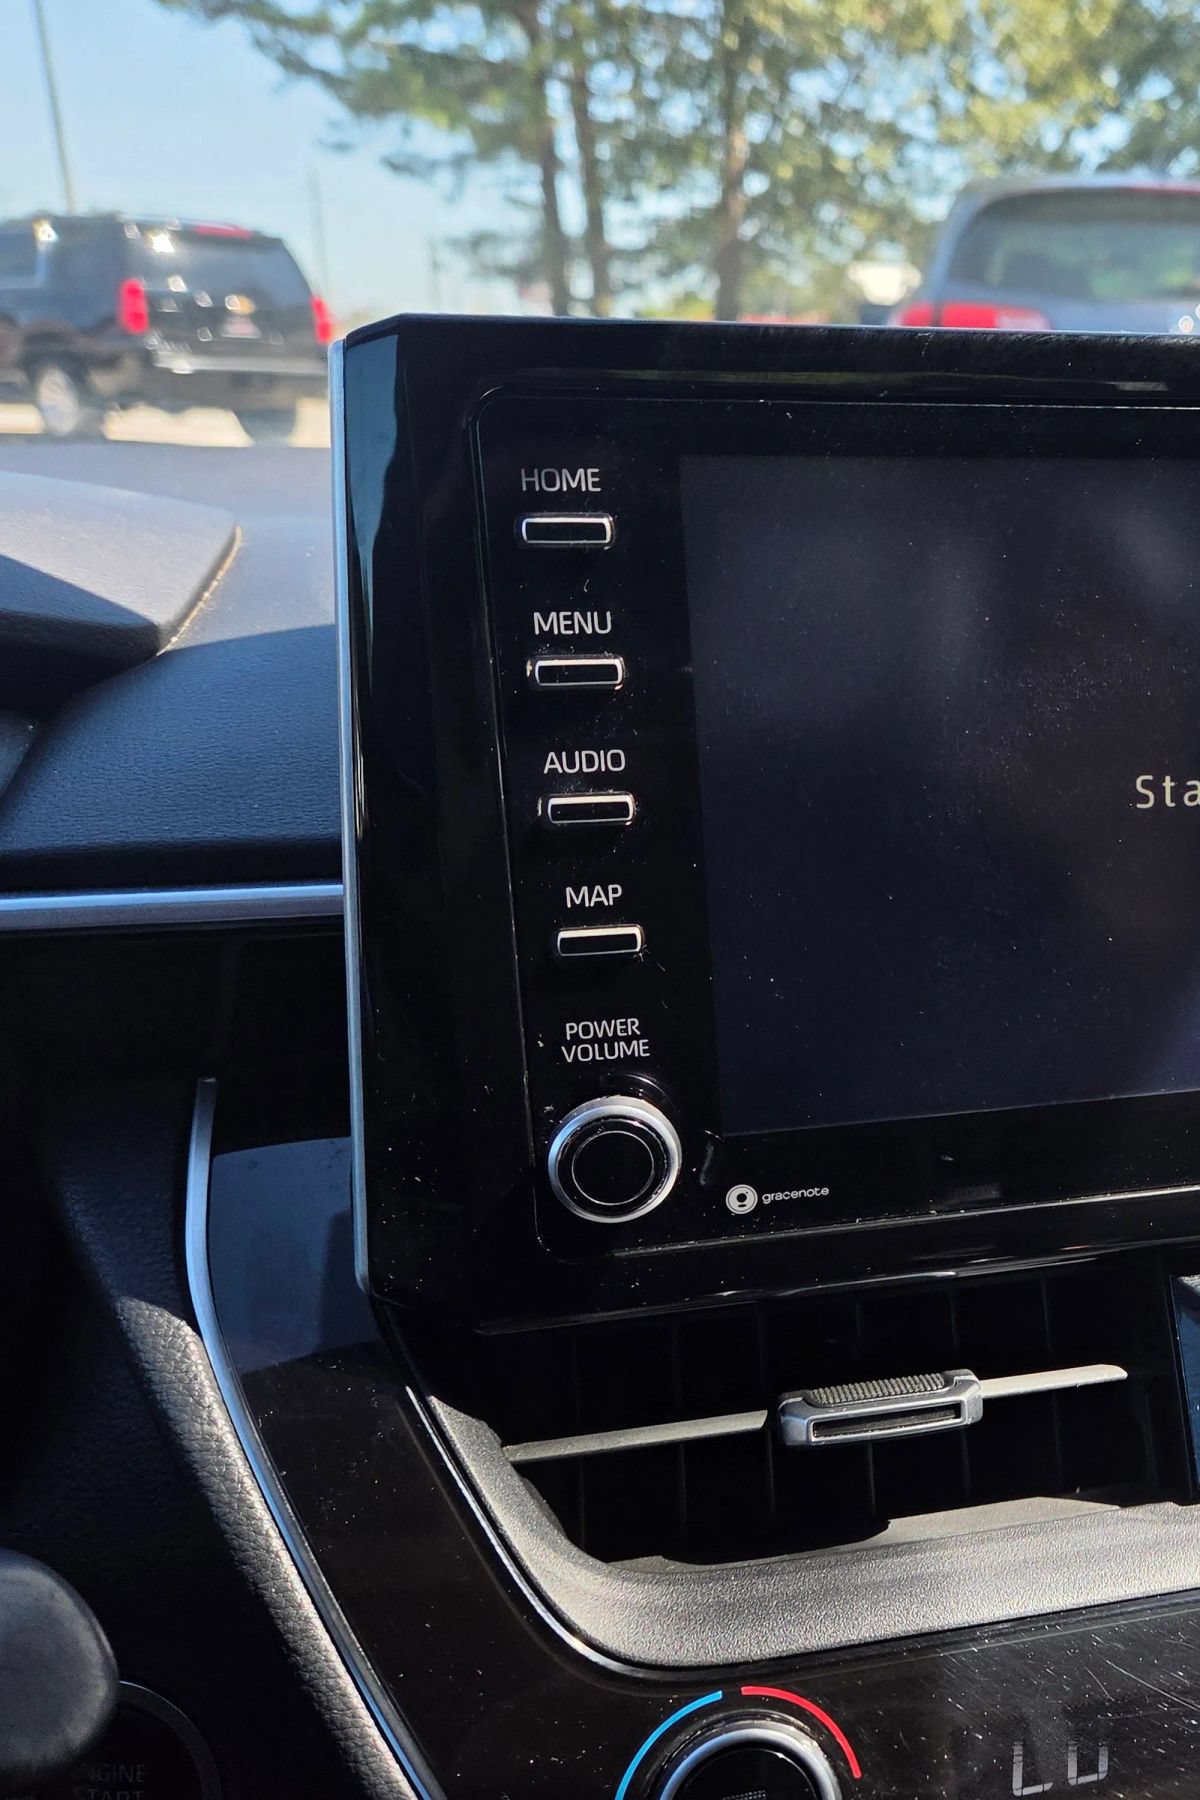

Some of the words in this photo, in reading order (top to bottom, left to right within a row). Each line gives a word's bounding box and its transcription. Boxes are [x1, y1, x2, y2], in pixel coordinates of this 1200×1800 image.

[521, 468, 601, 492] HOME
[533, 610, 612, 635] MENU
[543, 750, 626, 774] AUDIO
[565, 884, 623, 908] MAP
[565, 1018, 641, 1040] POWER
[561, 1039, 650, 1063] VOLUME
[762, 1187, 830, 1205] gracenote
